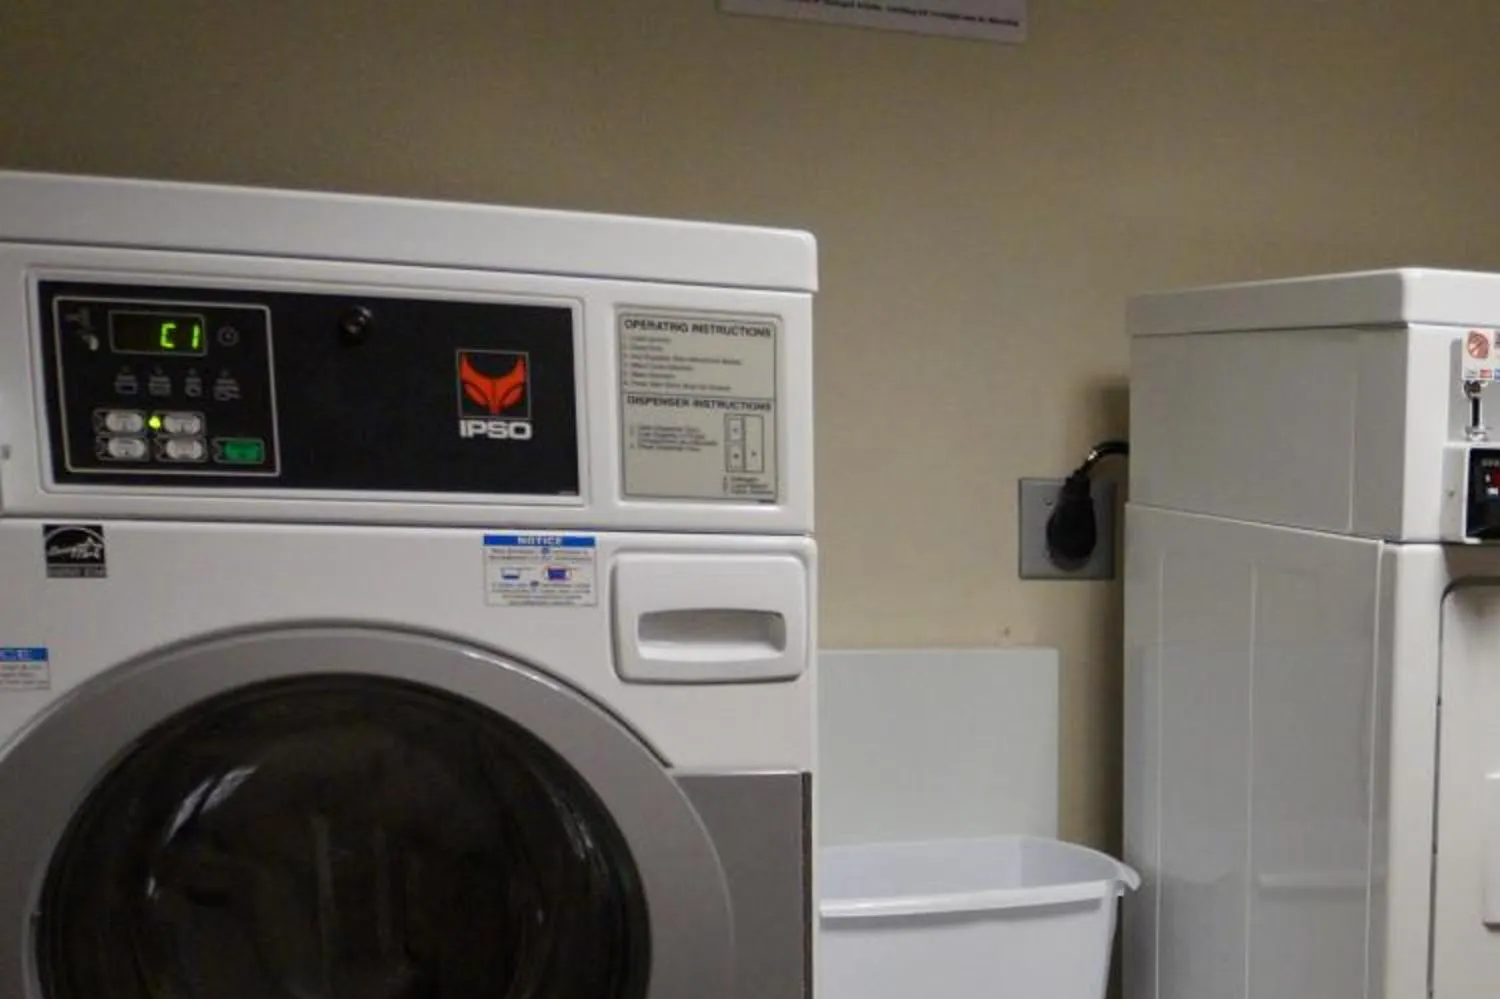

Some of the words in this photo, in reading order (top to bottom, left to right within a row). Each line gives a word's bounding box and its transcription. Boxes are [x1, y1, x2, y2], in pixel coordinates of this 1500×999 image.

[624, 319, 689, 334] OPERATING
[691, 323, 771, 337] INSTRUCTIONS
[627, 395, 690, 409] DISPENSER
[692, 400, 771, 411] INSTRUCTIONS
[459, 419, 533, 440] IPSO
